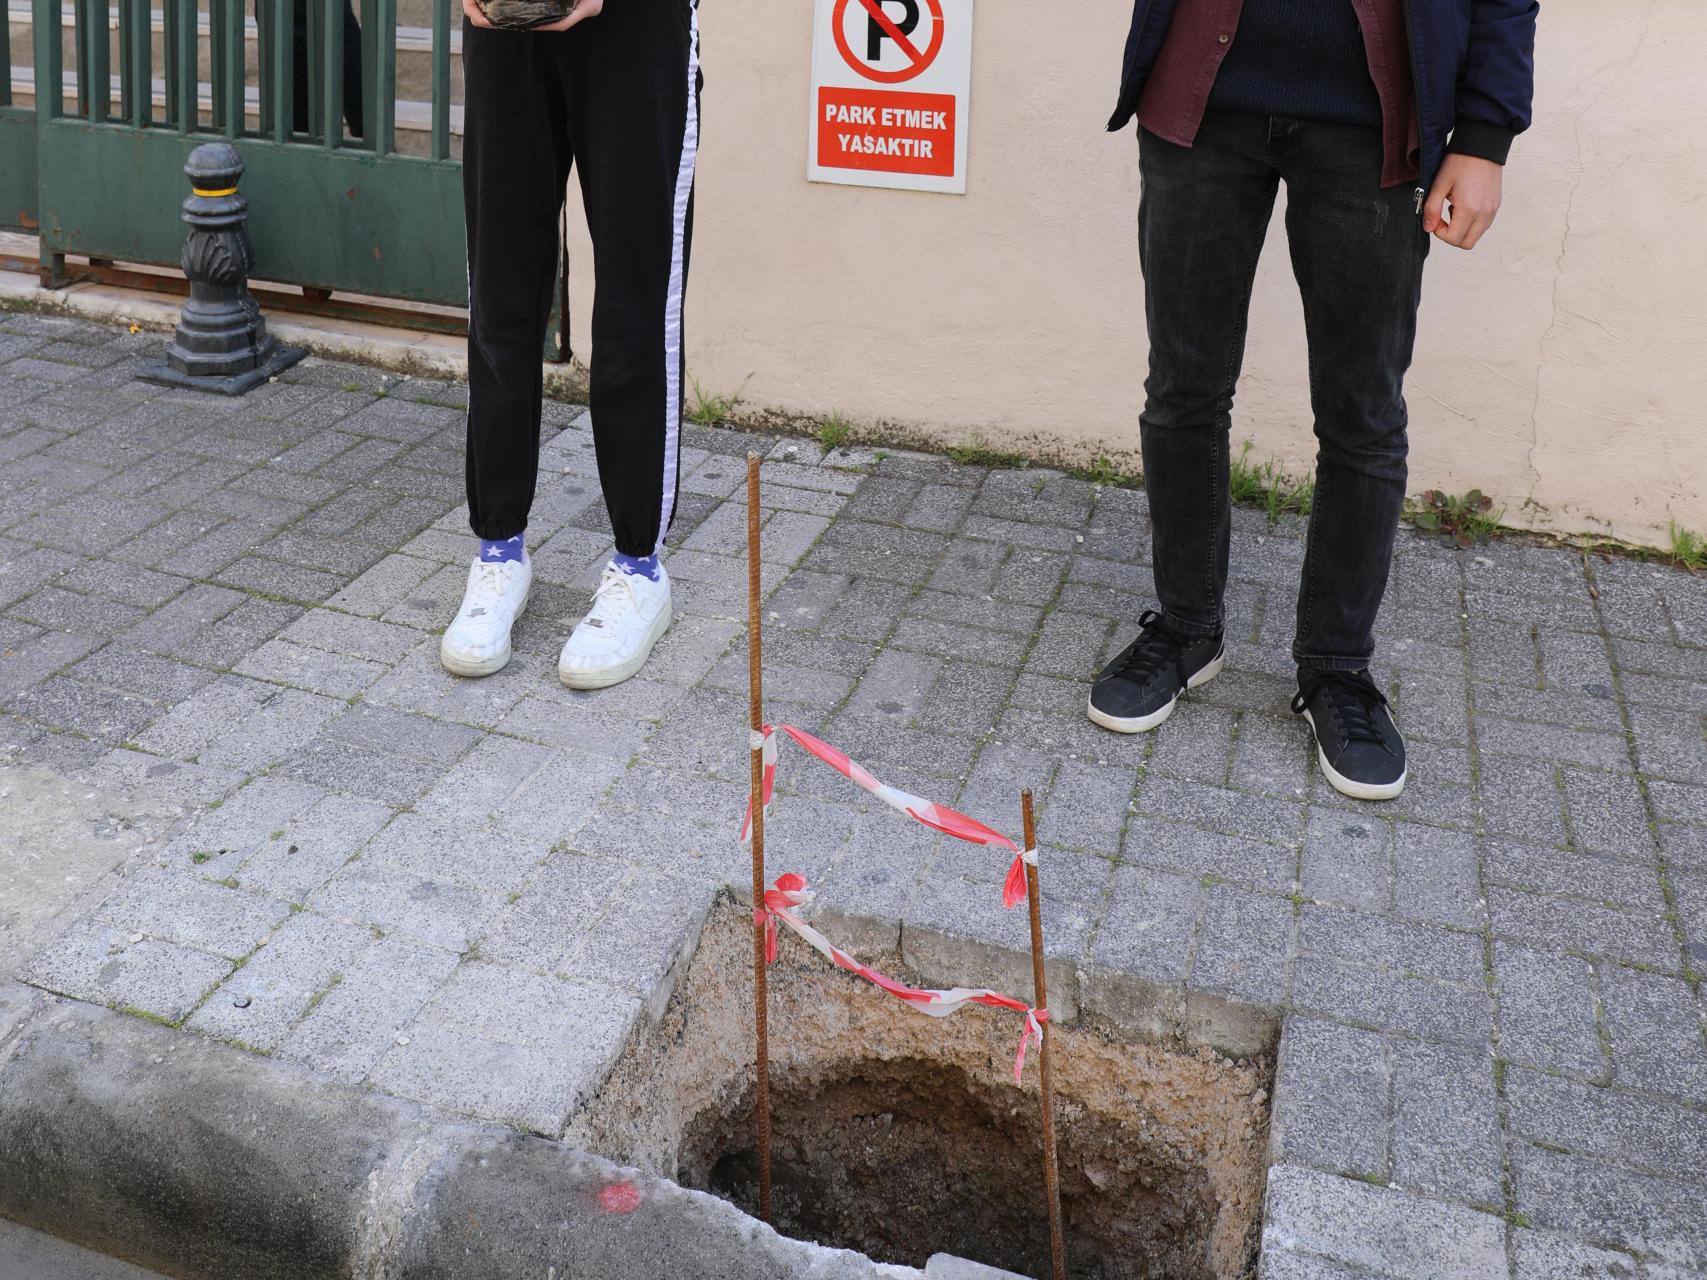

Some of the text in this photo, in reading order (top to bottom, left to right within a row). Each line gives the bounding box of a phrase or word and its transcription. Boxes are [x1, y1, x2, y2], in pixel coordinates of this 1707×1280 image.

[825, 103, 947, 130] PARK ETMEK
[838, 133, 933, 159] YASAKTIR
